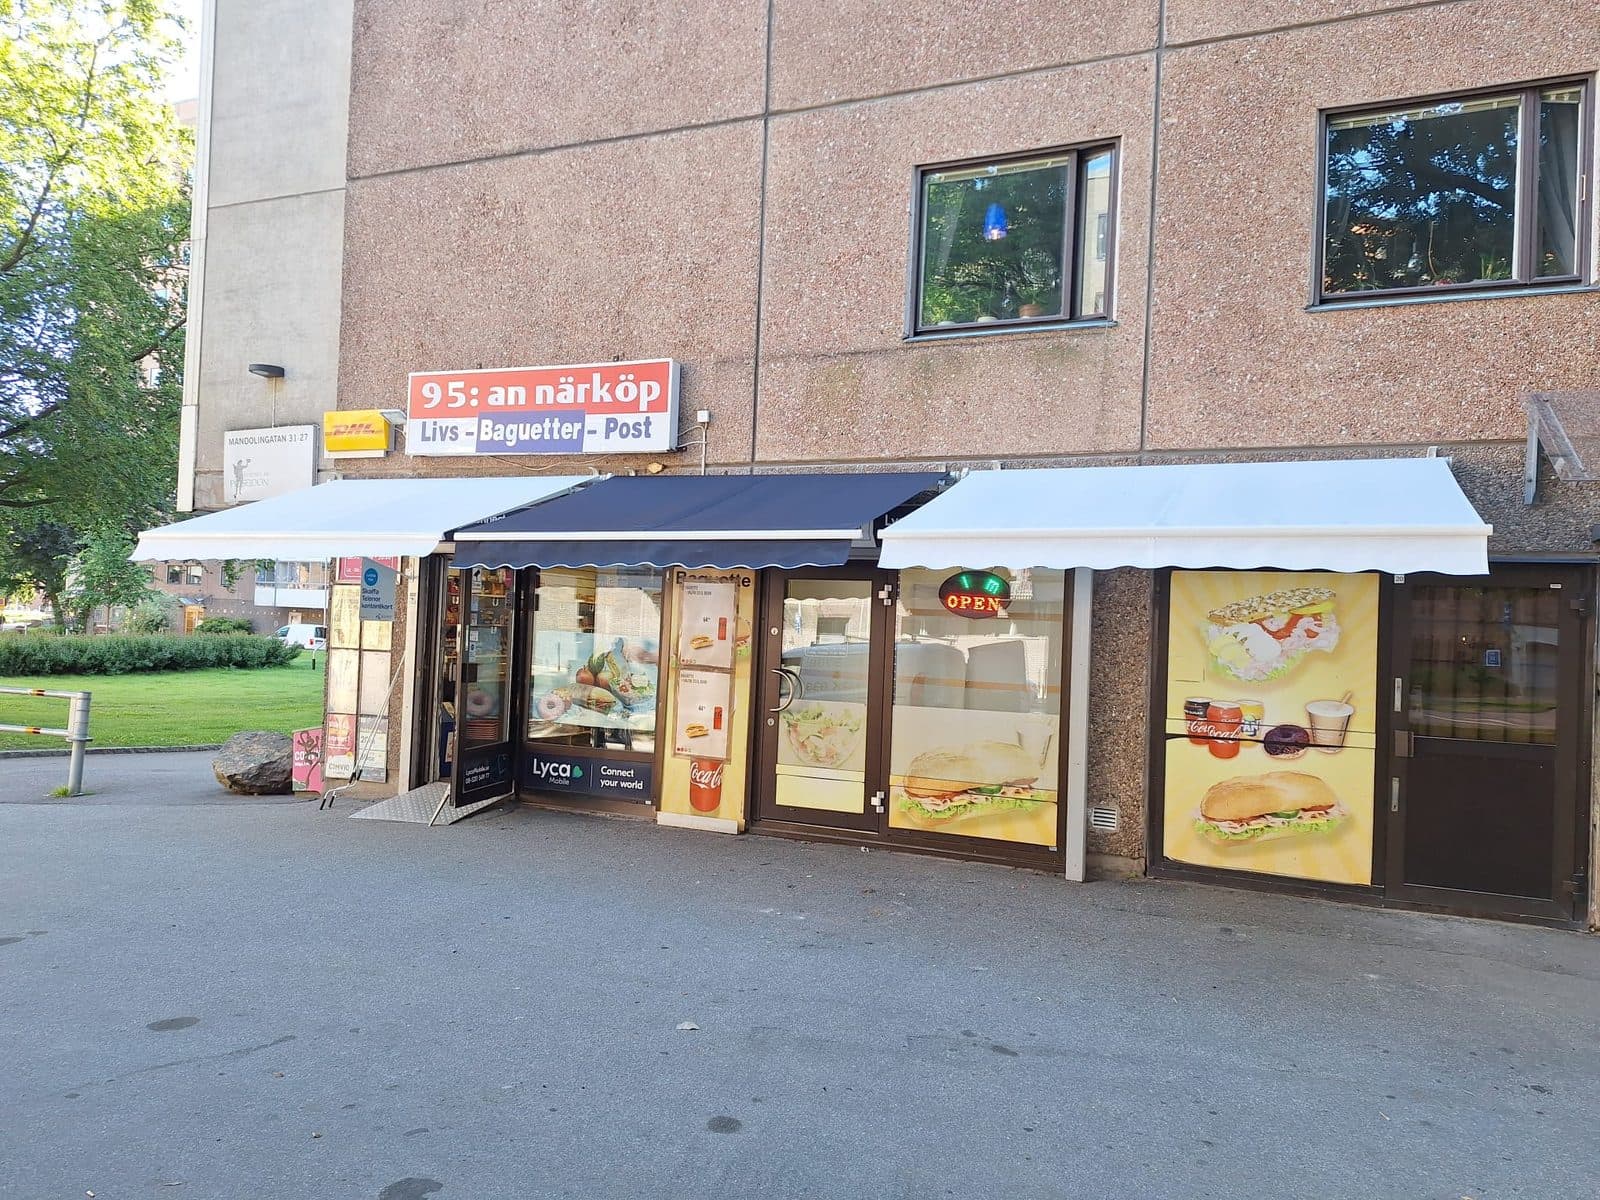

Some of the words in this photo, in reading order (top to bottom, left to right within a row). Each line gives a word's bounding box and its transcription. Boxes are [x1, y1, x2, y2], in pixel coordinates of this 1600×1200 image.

[487, 384, 527, 407] an
[535, 371, 661, 412] närköp
[421, 420, 460, 442] Livs
[480, 417, 583, 448] Baguetter
[604, 415, 653, 440] Post
[228, 433, 287, 446] MANDOLINGATAN
[947, 595, 999, 611] OPEN
[533, 758, 571, 778] Lyca
[600, 765, 635, 778] Connect
[548, 776, 570, 786] Mobile
[600, 779, 619, 788] your
[620, 780, 644, 790] world
